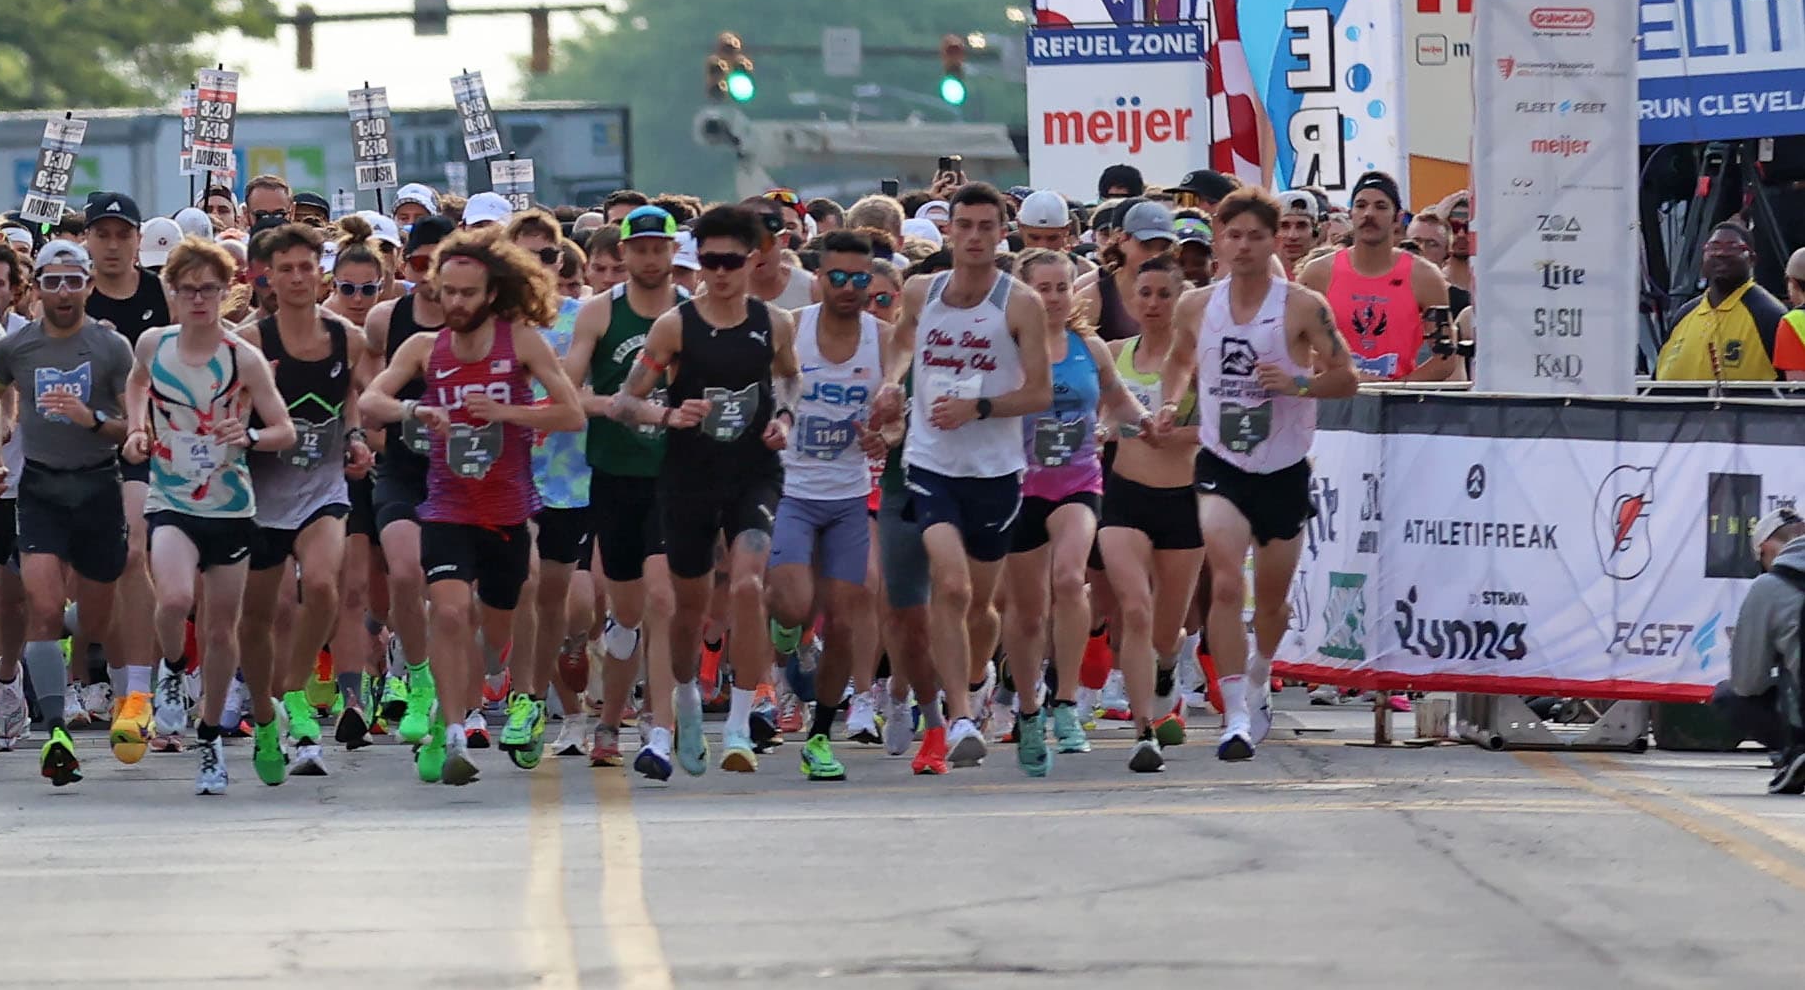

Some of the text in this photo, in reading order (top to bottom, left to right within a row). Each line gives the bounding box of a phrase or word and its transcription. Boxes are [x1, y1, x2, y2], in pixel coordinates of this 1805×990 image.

[1033, 33, 1198, 57] REFUEL ZONE
[200, 100, 232, 120] 3:20
[1515, 102, 1607, 113] FLEET FEET
[1638, 90, 1805, 120] RUN CLEVEL
[199, 120, 229, 139] 7:38
[356, 118, 386, 137] 1:40
[1043, 96, 1193, 154] meijer
[357, 138, 388, 158] 7:38
[469, 136, 498, 156] MUSH
[1531, 135, 1591, 158] meijer
[43, 149, 73, 171] 1:30
[195, 149, 228, 167] MUSH
[36, 170, 69, 192] 6:52
[361, 165, 393, 184] MUSH
[27, 197, 61, 219] MUSH
[1541, 261, 1586, 290] Lite
[927, 328, 991, 349] Ohio State
[923, 350, 997, 374] Running Club
[1534, 354, 1583, 378] K&D
[723, 401, 740, 414] 25
[1239, 414, 1251, 428] 4
[303, 433, 318, 446] 12
[470, 437, 479, 450] 7
[814, 429, 847, 444] 1141
[191, 444, 209, 456] 64
[1403, 519, 1558, 550] ATHLETIFREAK
[1482, 591, 1529, 606] STRAVA
[1605, 622, 1694, 657] FLEET
